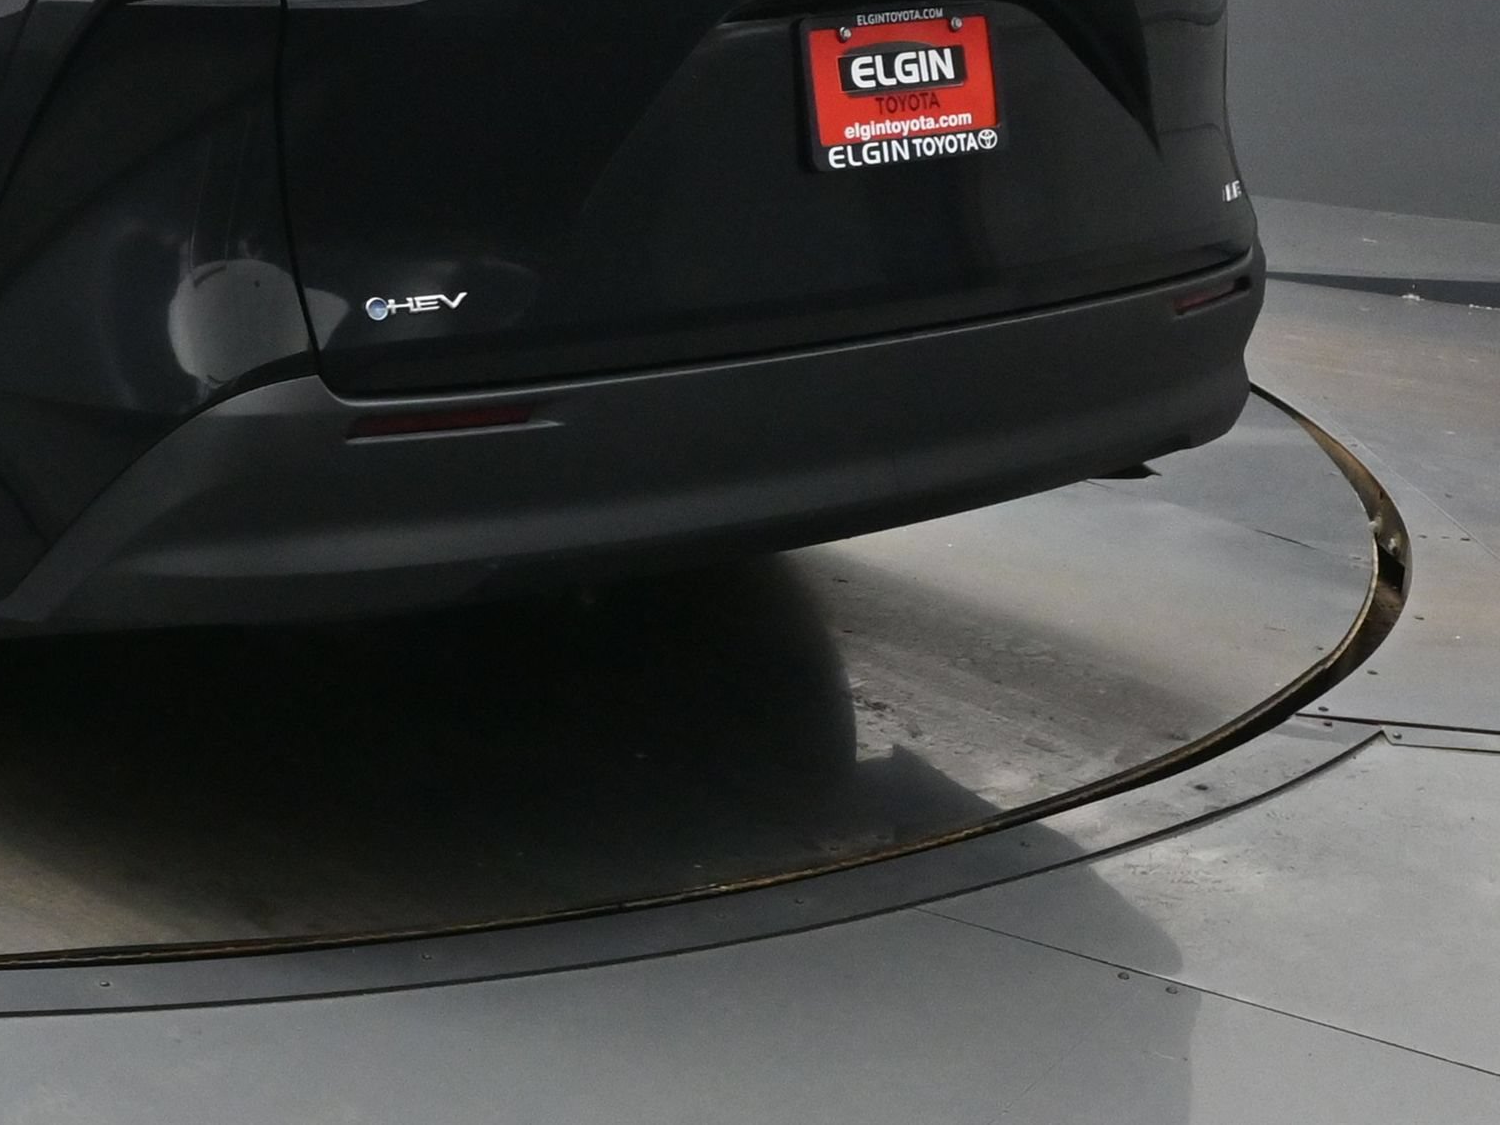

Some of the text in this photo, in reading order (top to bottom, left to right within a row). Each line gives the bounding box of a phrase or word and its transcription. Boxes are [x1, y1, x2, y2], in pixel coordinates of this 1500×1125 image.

[857, 7, 944, 26] ELGINTOYOTA.COM
[850, 47, 955, 88] ELGIN
[875, 92, 941, 115] TOYOTA
[844, 112, 972, 140] elgintoyota.com
[828, 132, 978, 168] ELGIN TOYOTA
